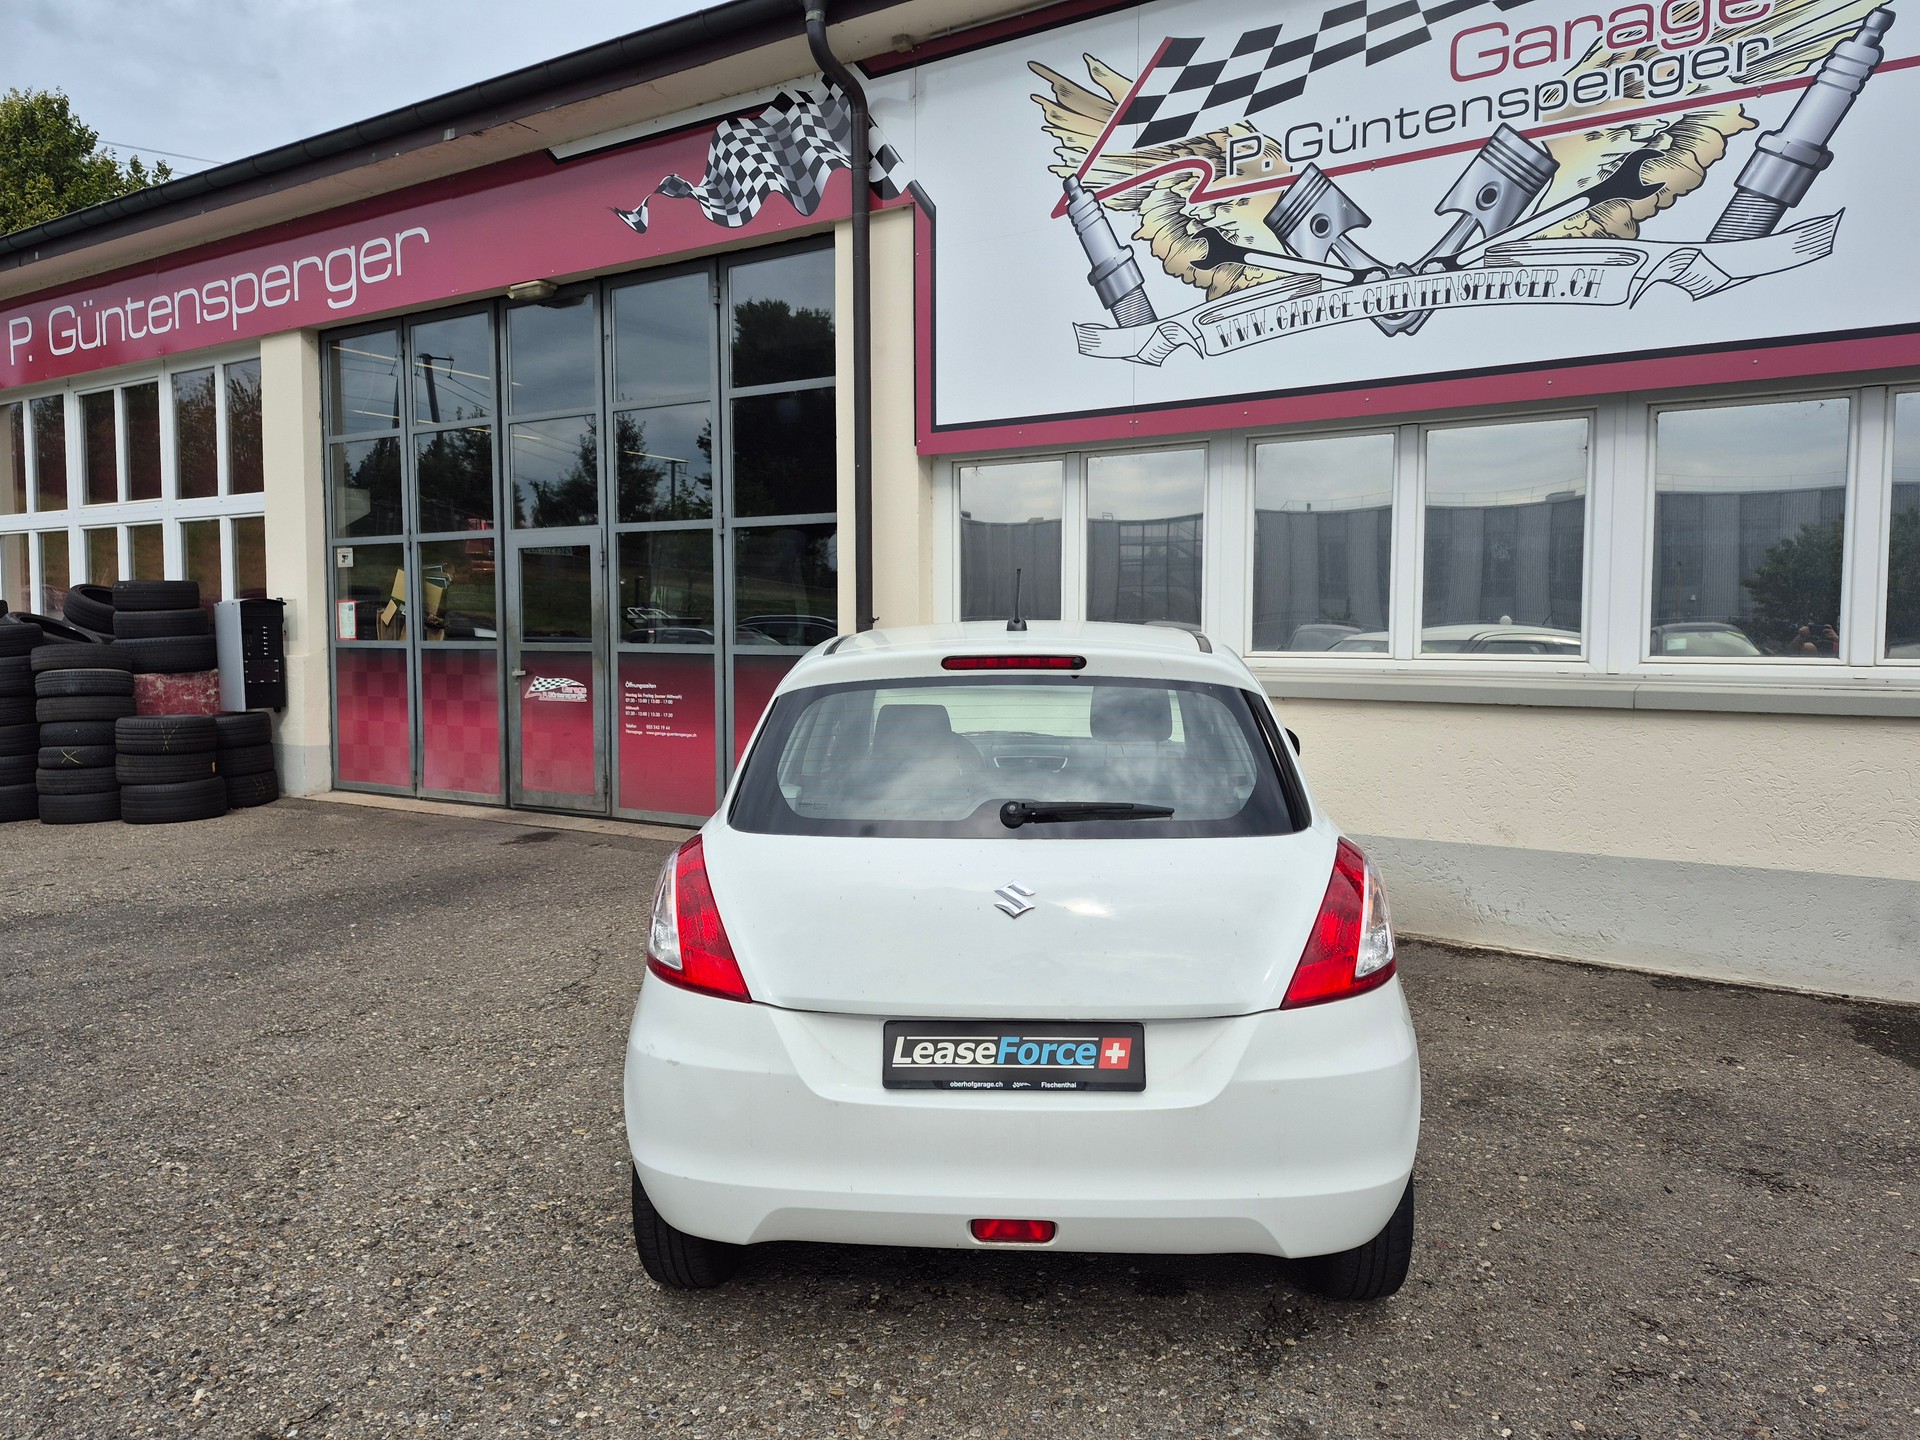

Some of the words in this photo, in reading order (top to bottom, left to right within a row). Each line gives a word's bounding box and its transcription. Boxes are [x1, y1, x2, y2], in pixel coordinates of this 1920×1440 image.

[1449, 0, 1771, 83] Garage
[1228, 138, 1271, 175] P.
[1285, 37, 1770, 164] Güntensperger
[8, 317, 34, 366] P.
[48, 226, 430, 357] Güntensperger
[1215, 267, 1606, 348] WWW.GARAGE-GUENTENSPERGER.CH
[892, 1036, 1098, 1065] LeaseForce
[949, 1081, 1004, 1089] oberhofgarage.ch
